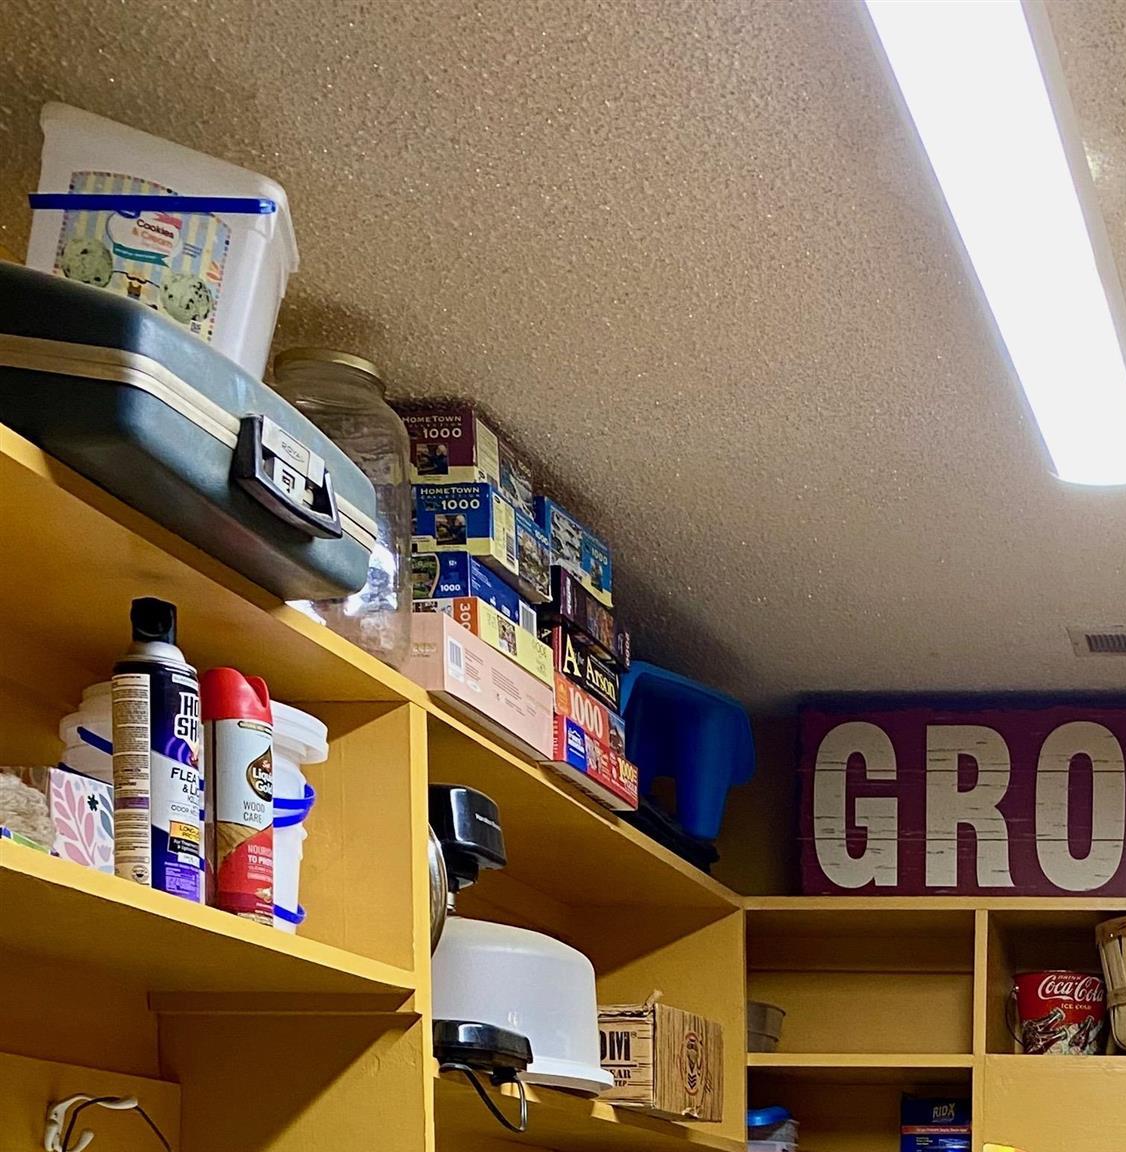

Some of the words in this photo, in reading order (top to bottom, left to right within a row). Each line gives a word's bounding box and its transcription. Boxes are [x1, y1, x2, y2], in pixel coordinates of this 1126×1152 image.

[137, 219, 174, 239] Cookies
[423, 427, 462, 439] 1000
[441, 498, 480, 510] 1000
[440, 584, 461, 592] 1000
[586, 656, 616, 702] Arson
[568, 687, 603, 739] 1000
[243, 800, 265, 814] WOOD
[243, 812, 262, 824] CARE
